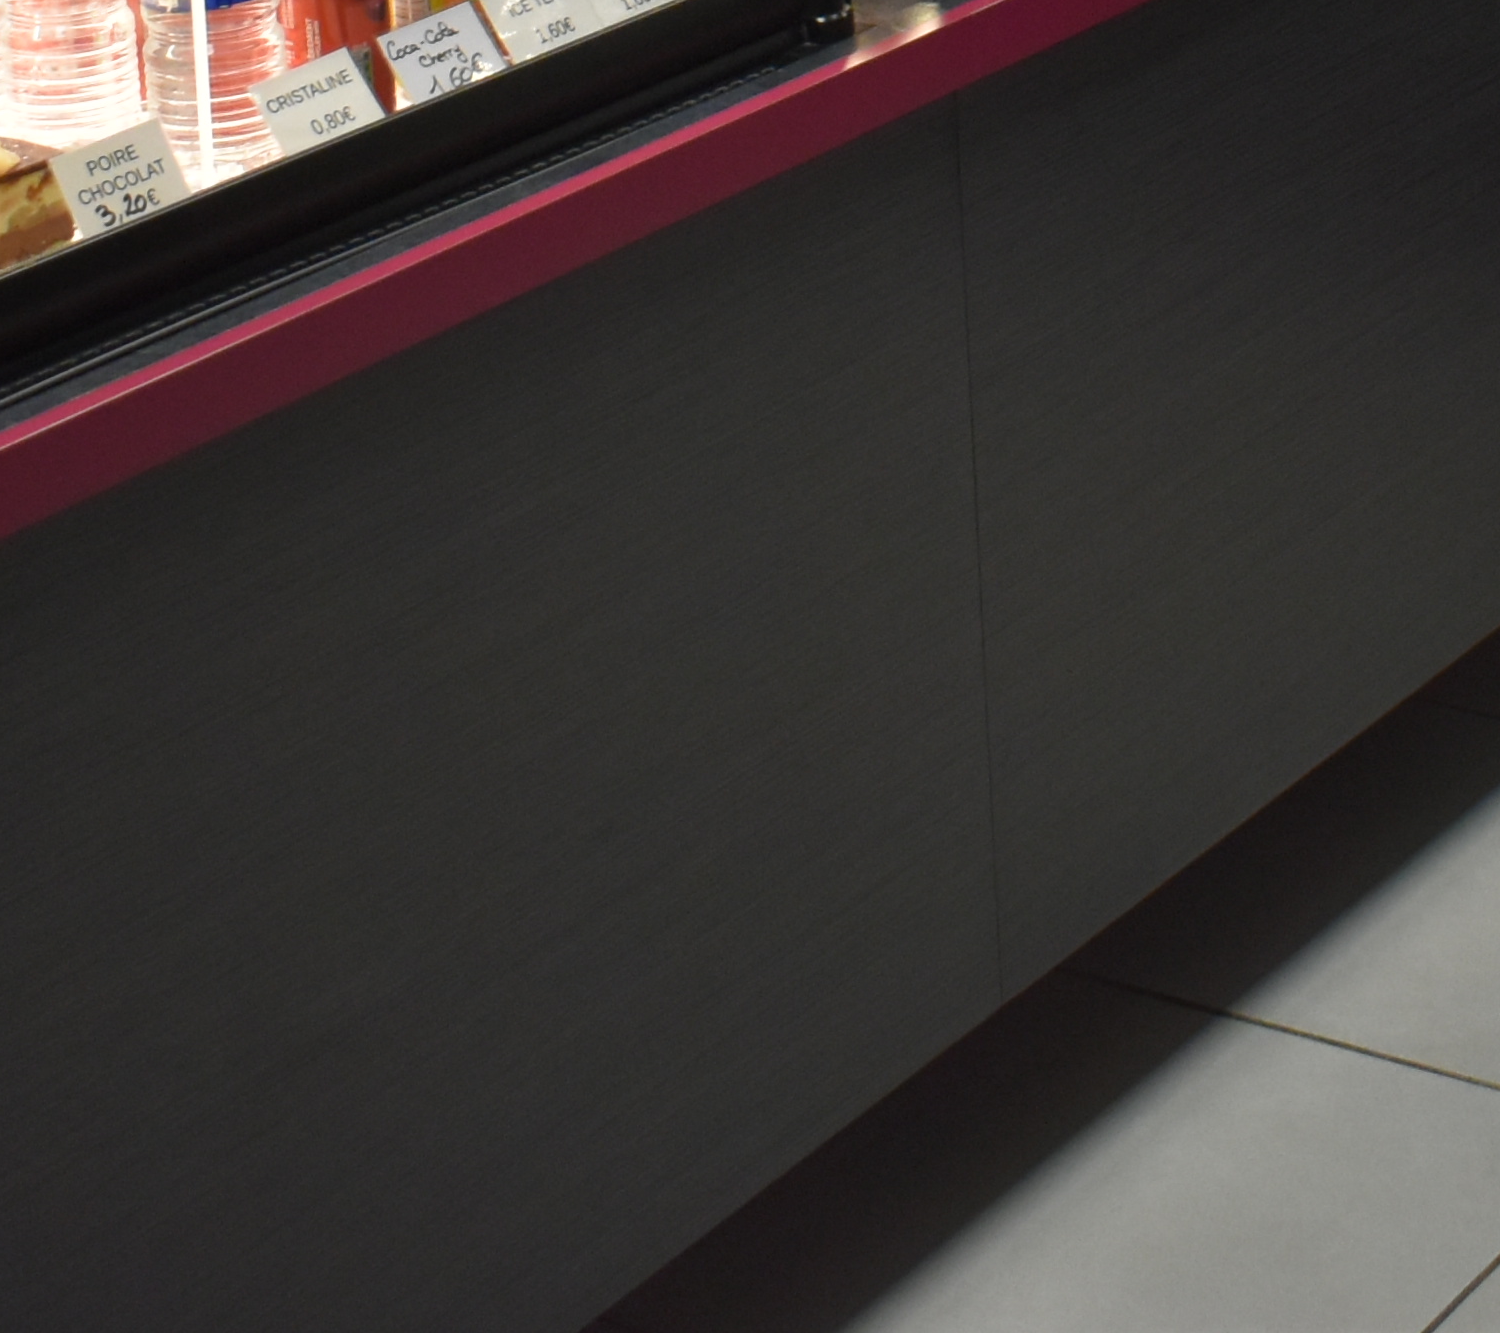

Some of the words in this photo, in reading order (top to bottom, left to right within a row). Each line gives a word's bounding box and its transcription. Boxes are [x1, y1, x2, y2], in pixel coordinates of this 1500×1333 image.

[386, 22, 460, 62] Coca-Cola
[266, 68, 354, 114] CRISTALINE
[310, 105, 357, 136] 0,80€
[86, 144, 140, 176] POIRE
[78, 158, 165, 205] CHOCOLAT
[95, 188, 160, 227] 3,20€
